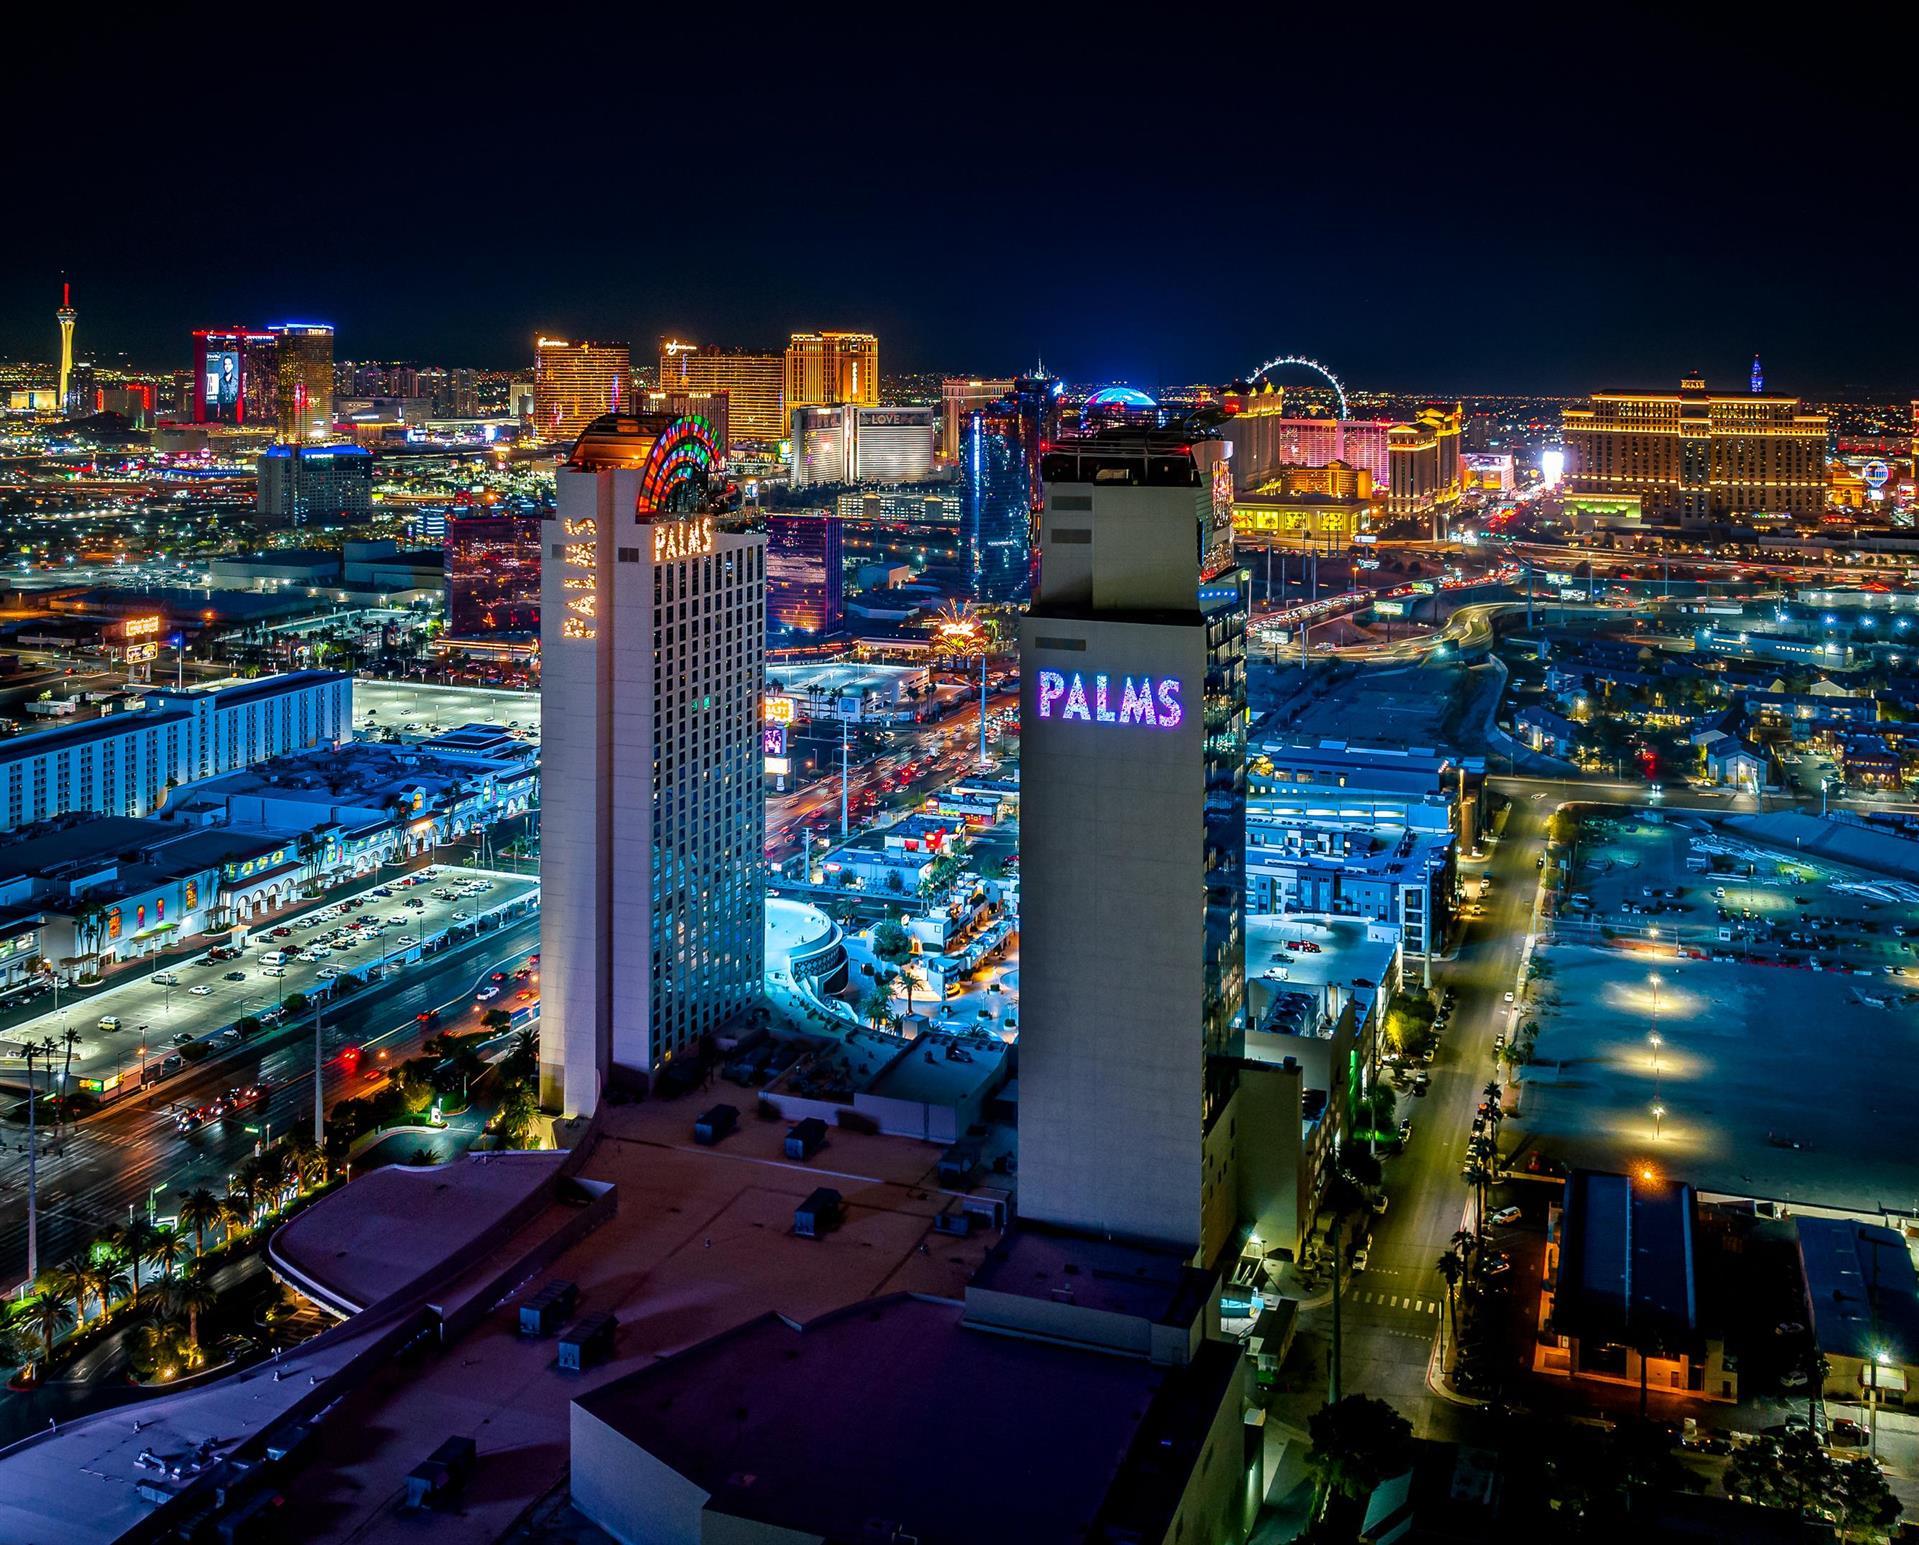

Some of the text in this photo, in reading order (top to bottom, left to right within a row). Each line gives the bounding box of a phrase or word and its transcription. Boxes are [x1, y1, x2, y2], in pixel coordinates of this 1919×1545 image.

[872, 414, 900, 425] LOVE
[654, 517, 712, 562] PALMS
[562, 517, 597, 639] PALMS
[1039, 671, 1182, 727] PALMS
